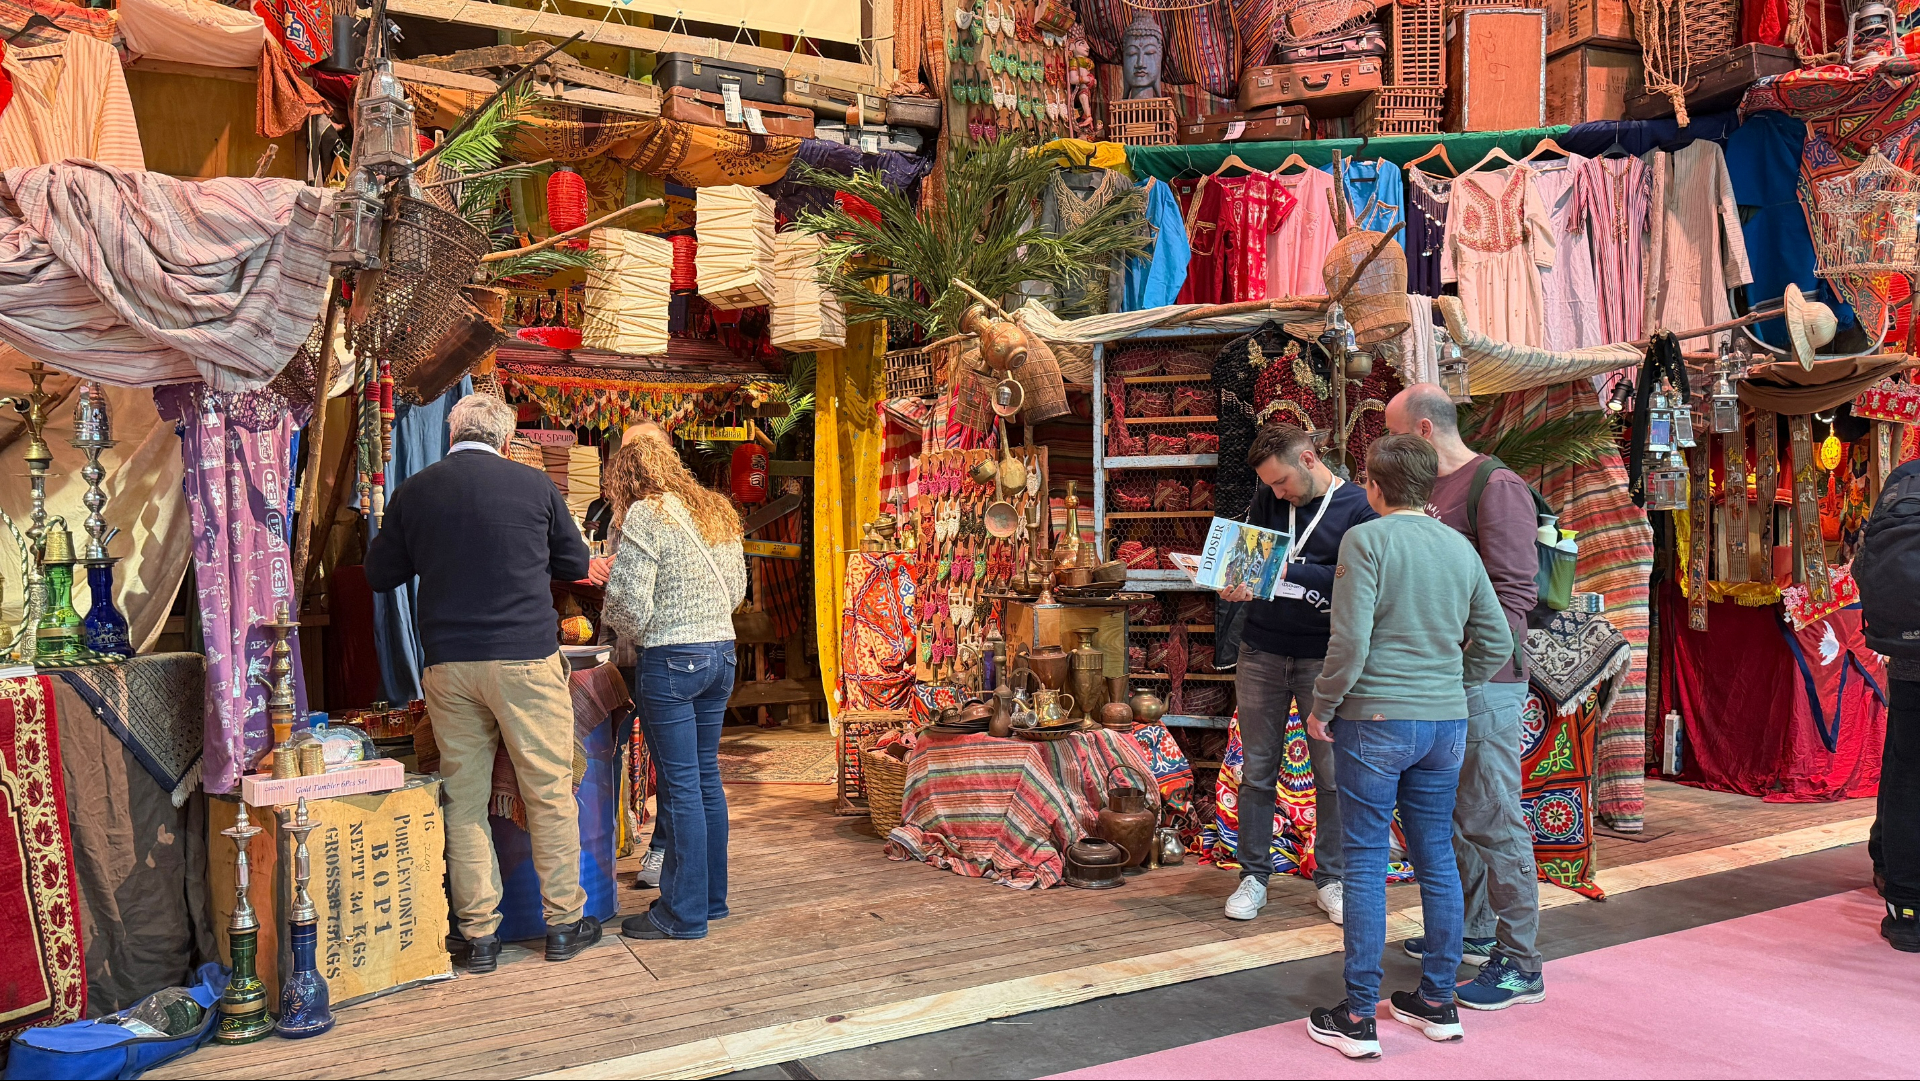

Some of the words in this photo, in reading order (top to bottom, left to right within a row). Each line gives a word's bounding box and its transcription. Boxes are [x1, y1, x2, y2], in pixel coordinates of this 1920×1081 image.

[1203, 524, 1225, 571] DJOSER
[295, 786, 311, 794] Gold
[313, 781, 340, 792] Tumbler
[357, 778, 367, 786] Set
[349, 820, 365, 881] NETT
[352, 921, 368, 968] KGS
